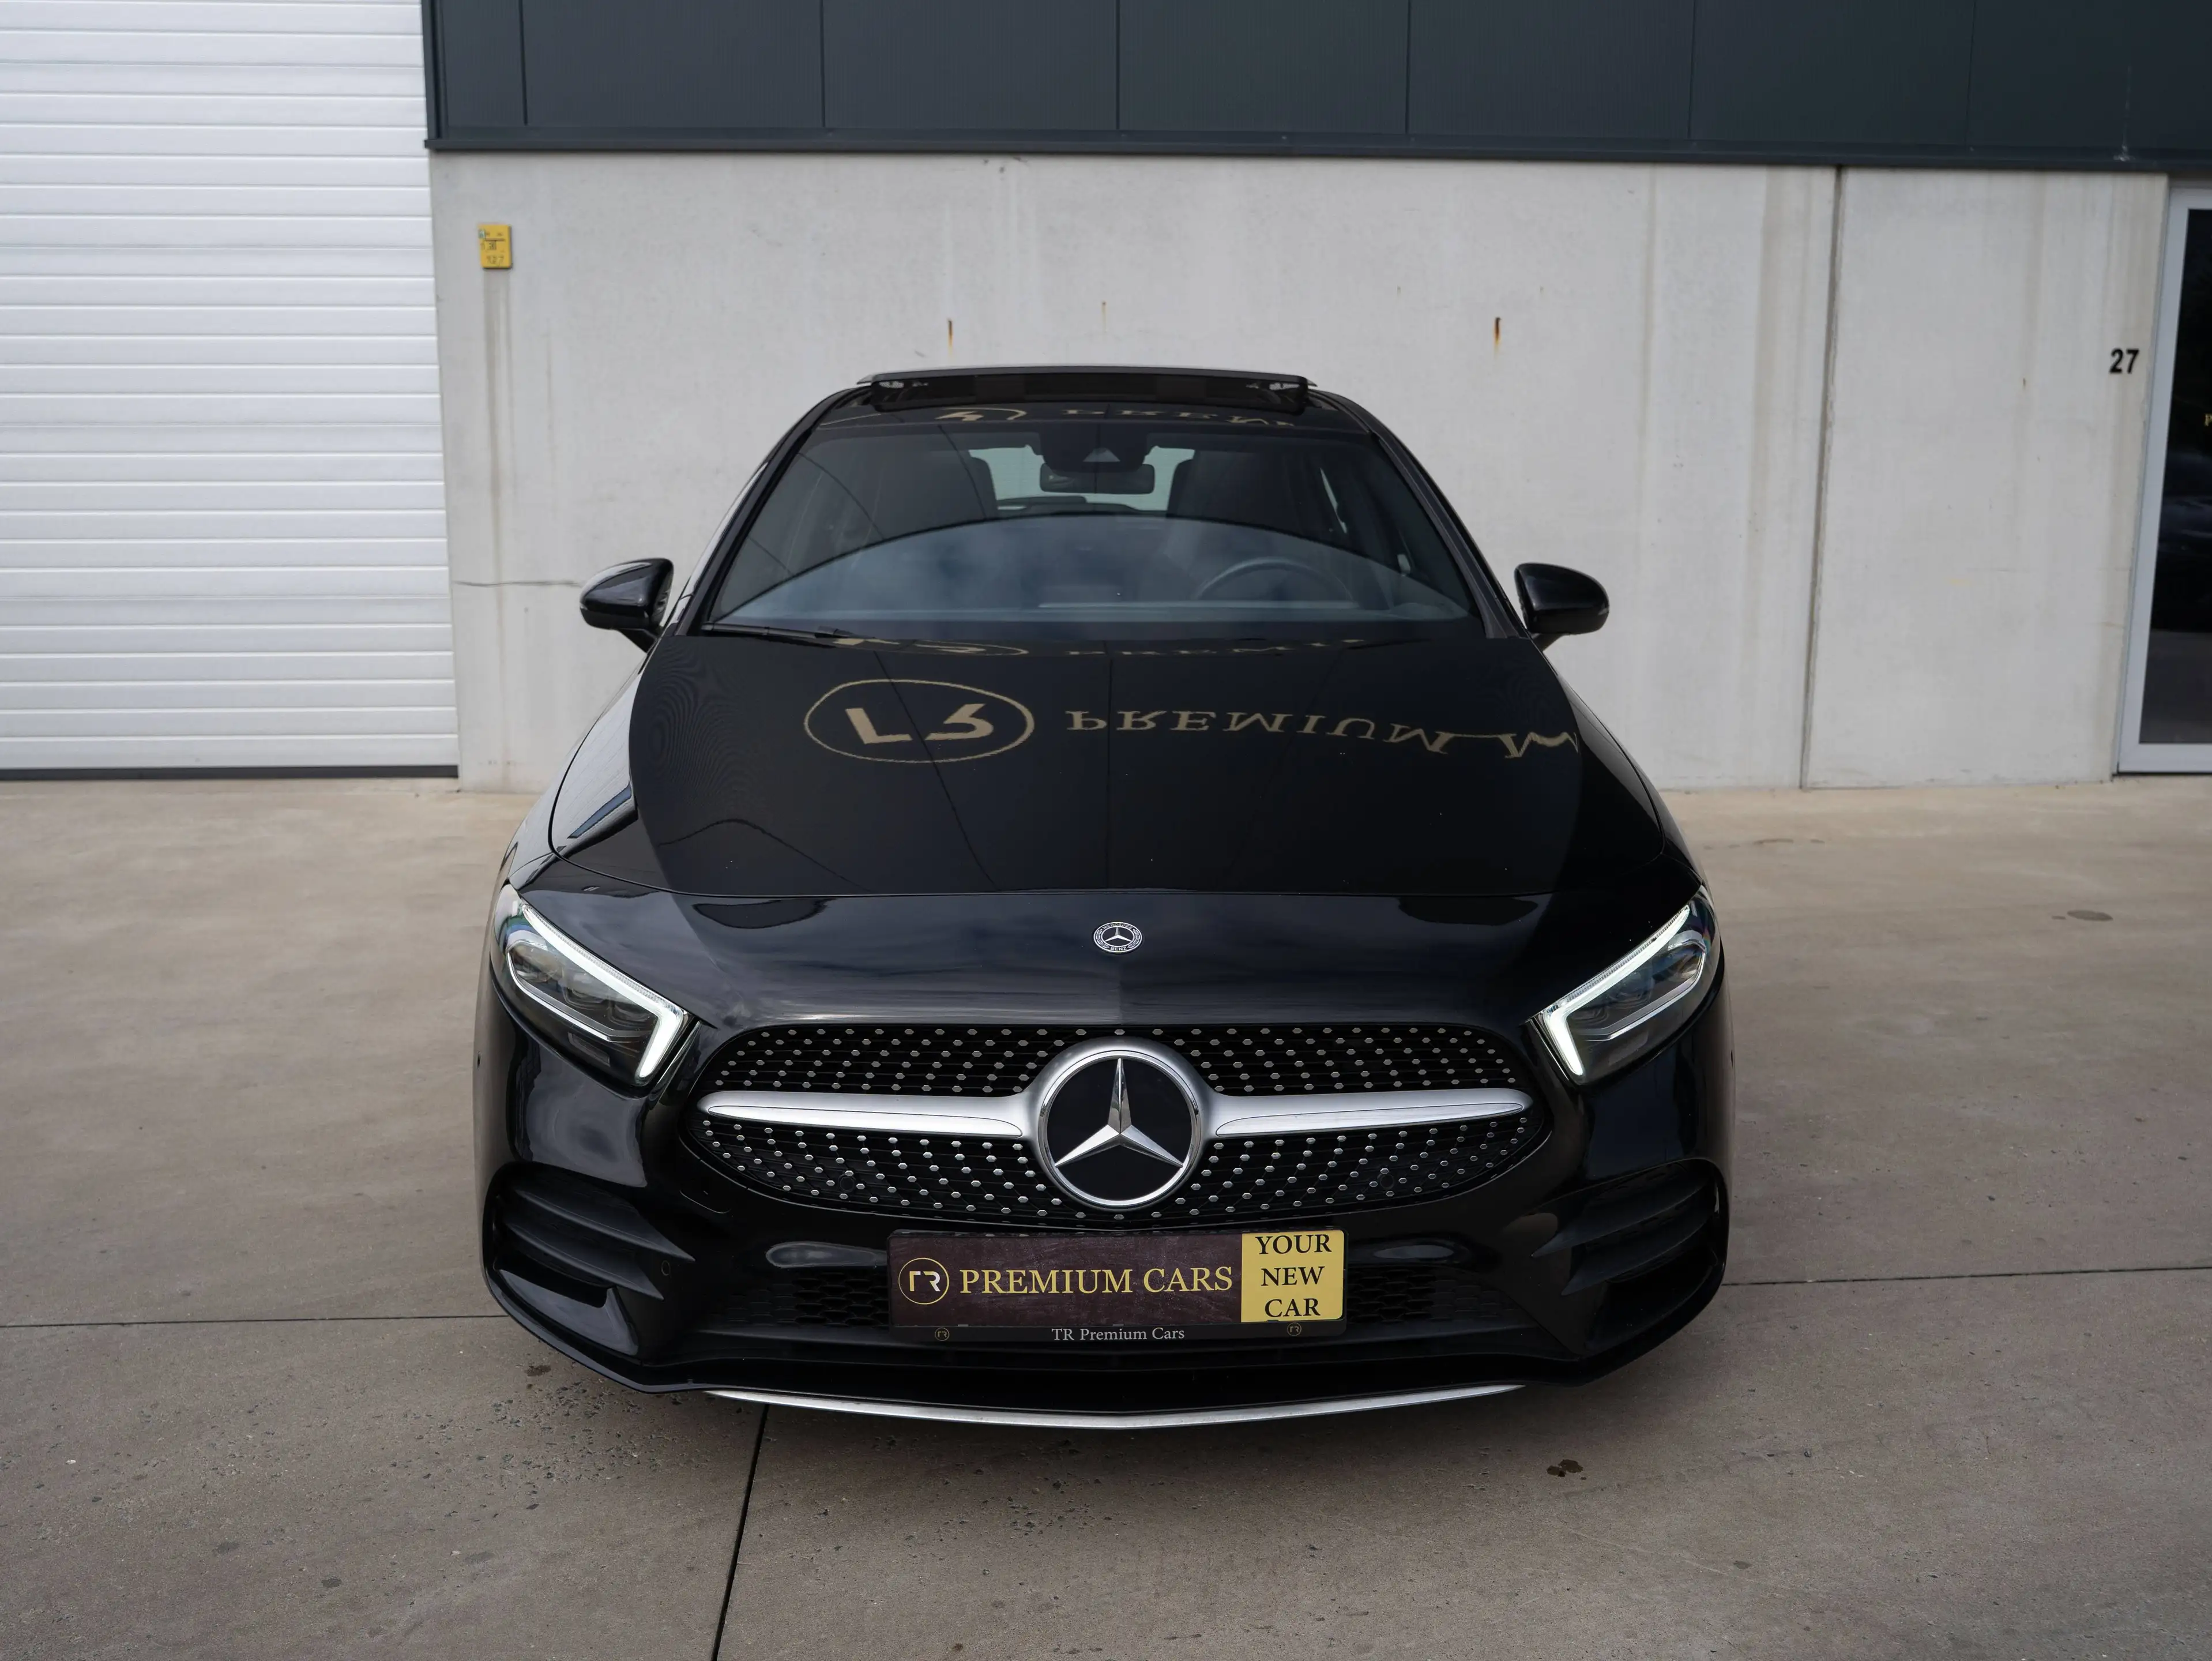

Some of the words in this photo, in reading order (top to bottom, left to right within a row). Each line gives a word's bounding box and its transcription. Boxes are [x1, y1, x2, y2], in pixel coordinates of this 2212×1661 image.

[2109, 348, 2139, 374] 27
[1255, 1234, 1332, 1254] YOUR
[960, 1269, 1133, 1294] PREMIUM
[1143, 1266, 1232, 1292] CARS
[1261, 1266, 1325, 1286] NEW
[1265, 1298, 1321, 1317] CAR
[1051, 1328, 1074, 1340] TR
[1079, 1328, 1147, 1340] Premium
[1152, 1327, 1185, 1339] Cars
